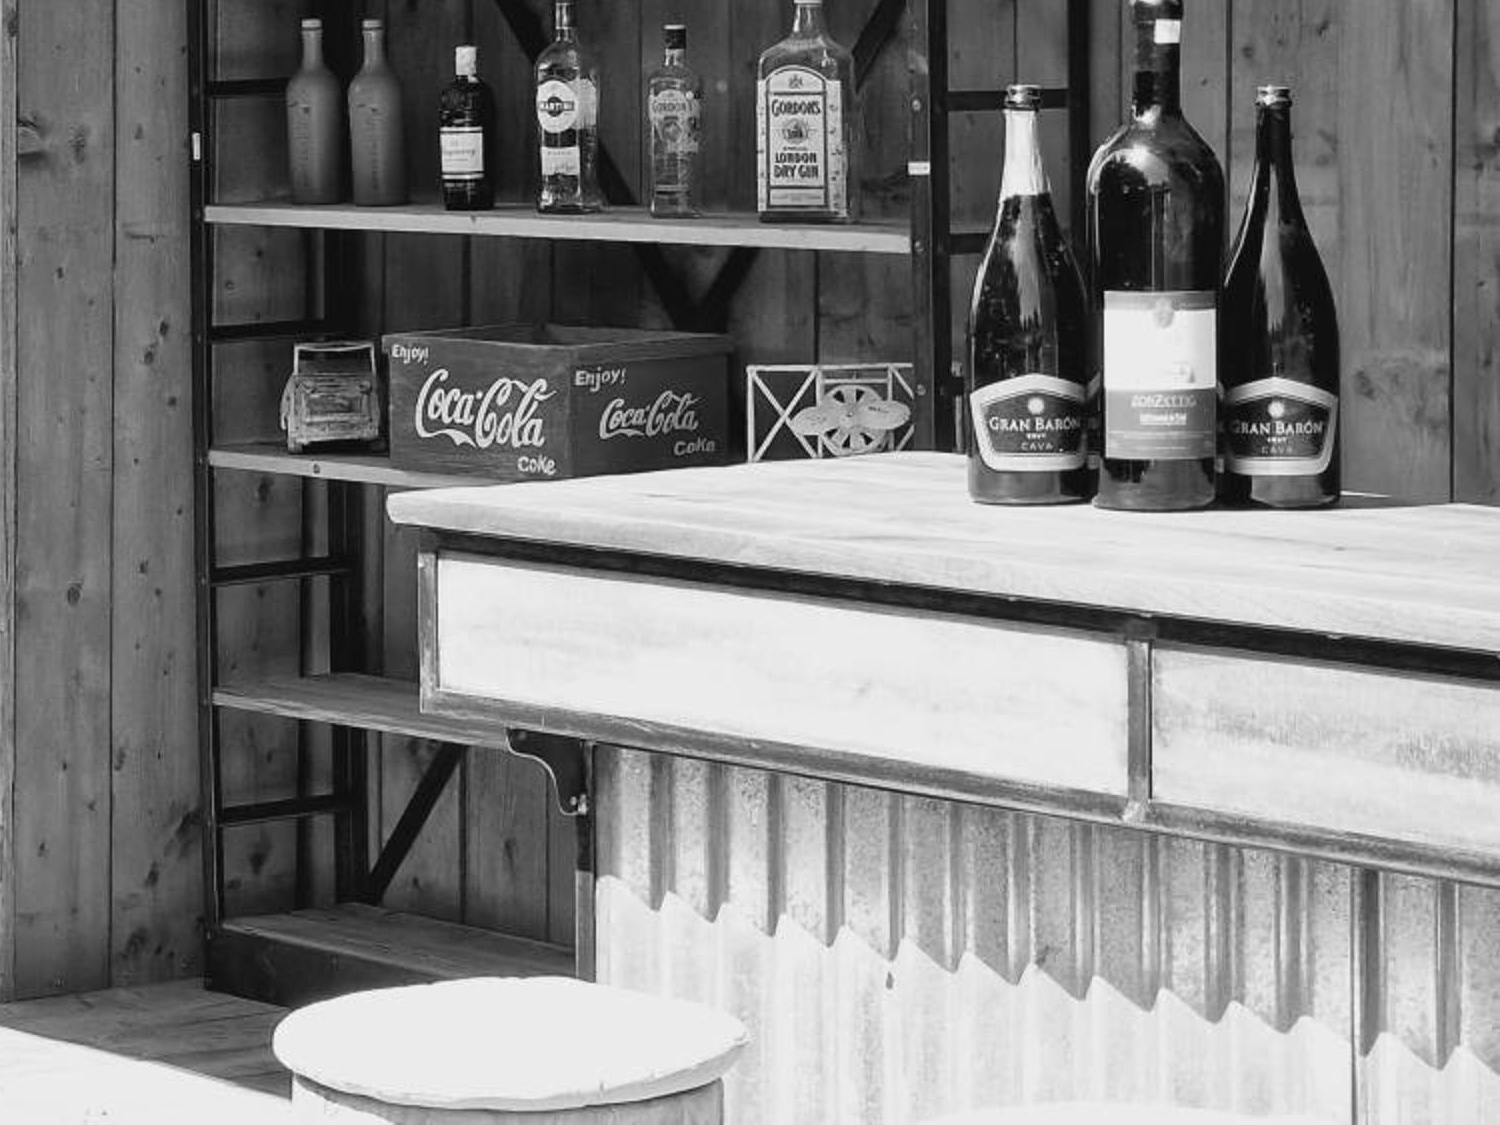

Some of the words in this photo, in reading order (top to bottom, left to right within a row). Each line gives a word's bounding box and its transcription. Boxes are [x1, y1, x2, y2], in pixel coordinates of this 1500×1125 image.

[775, 152, 817, 164] LONDON
[773, 165, 797, 178] DRY
[798, 165, 819, 178] GIN
[392, 344, 429, 365] Enjoy!
[575, 366, 626, 392] Enjoy!
[415, 369, 557, 448] Coca-Cola
[989, 416, 1031, 432] GRAN
[1020, 442, 1053, 451] CAVA
